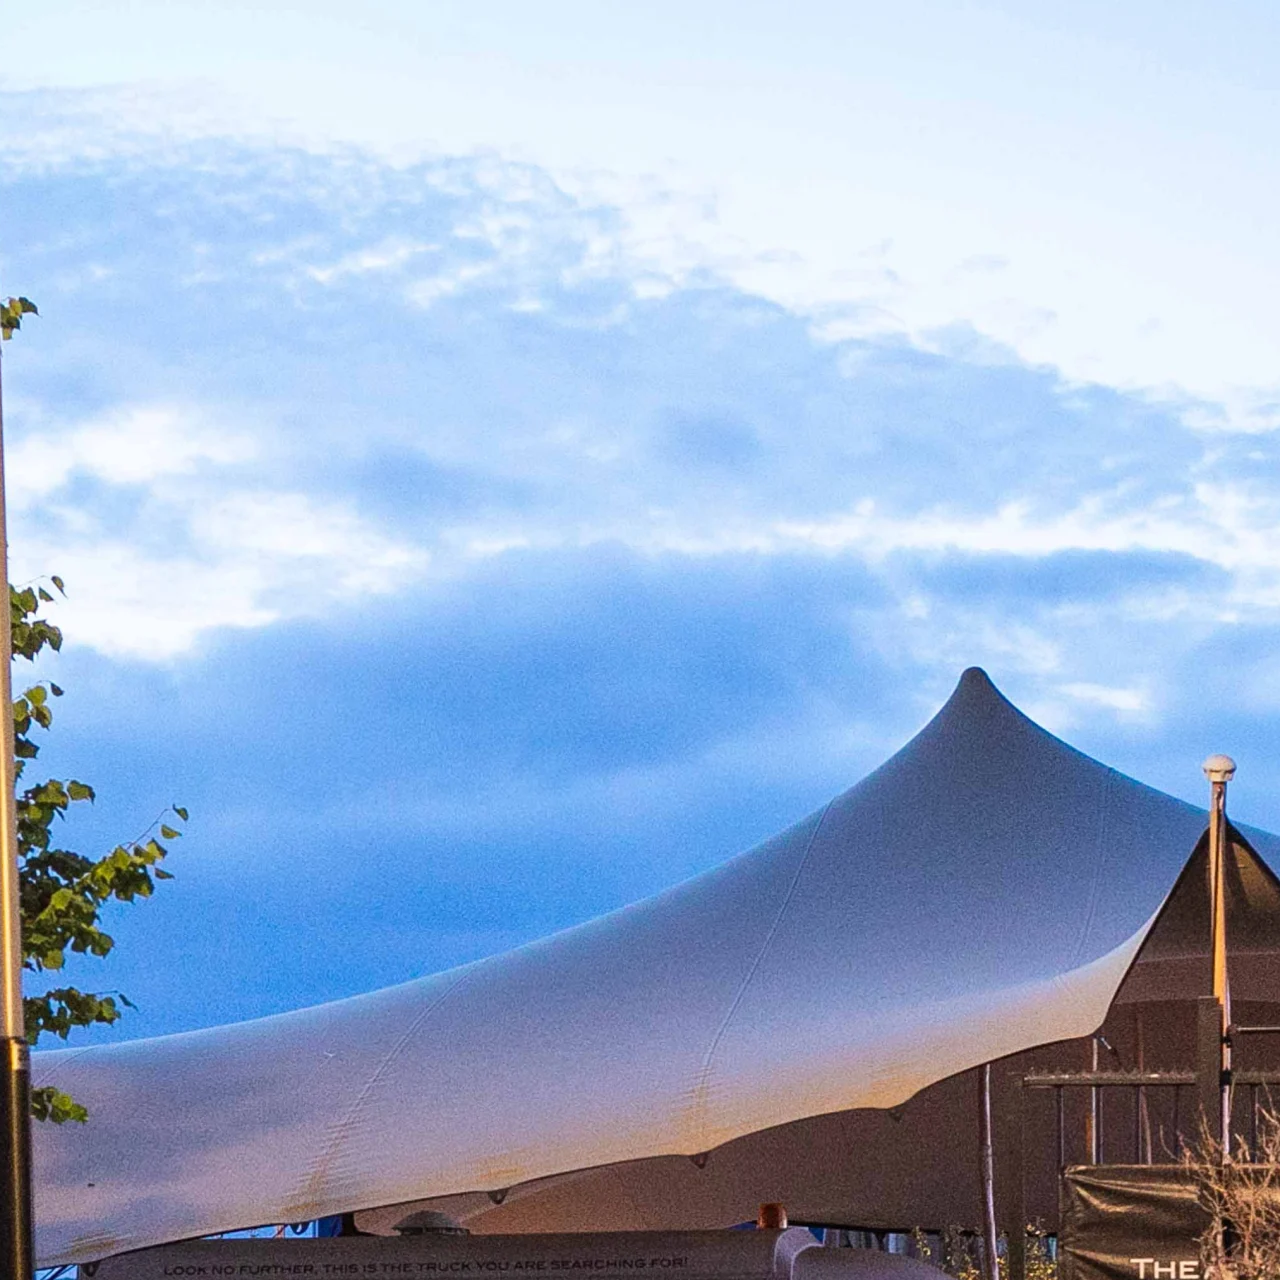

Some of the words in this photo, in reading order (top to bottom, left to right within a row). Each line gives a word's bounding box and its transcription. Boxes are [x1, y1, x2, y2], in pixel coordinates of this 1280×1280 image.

[164, 1264, 209, 1276] LOOK
[212, 1264, 235, 1276] NO
[239, 1263, 318, 1275] FURTHER,
[323, 1263, 358, 1274] THIS
[363, 1262, 377, 1274] IS
[383, 1262, 413, 1274] THE
[418, 1261, 471, 1273] TRUCK
[477, 1261, 510, 1272] YOU
[514, 1260, 546, 1271] ARE
[550, 1258, 646, 1270] SEARCHING
[651, 1256, 688, 1269] FOR!
[1130, 1257, 1200, 1280] THE
